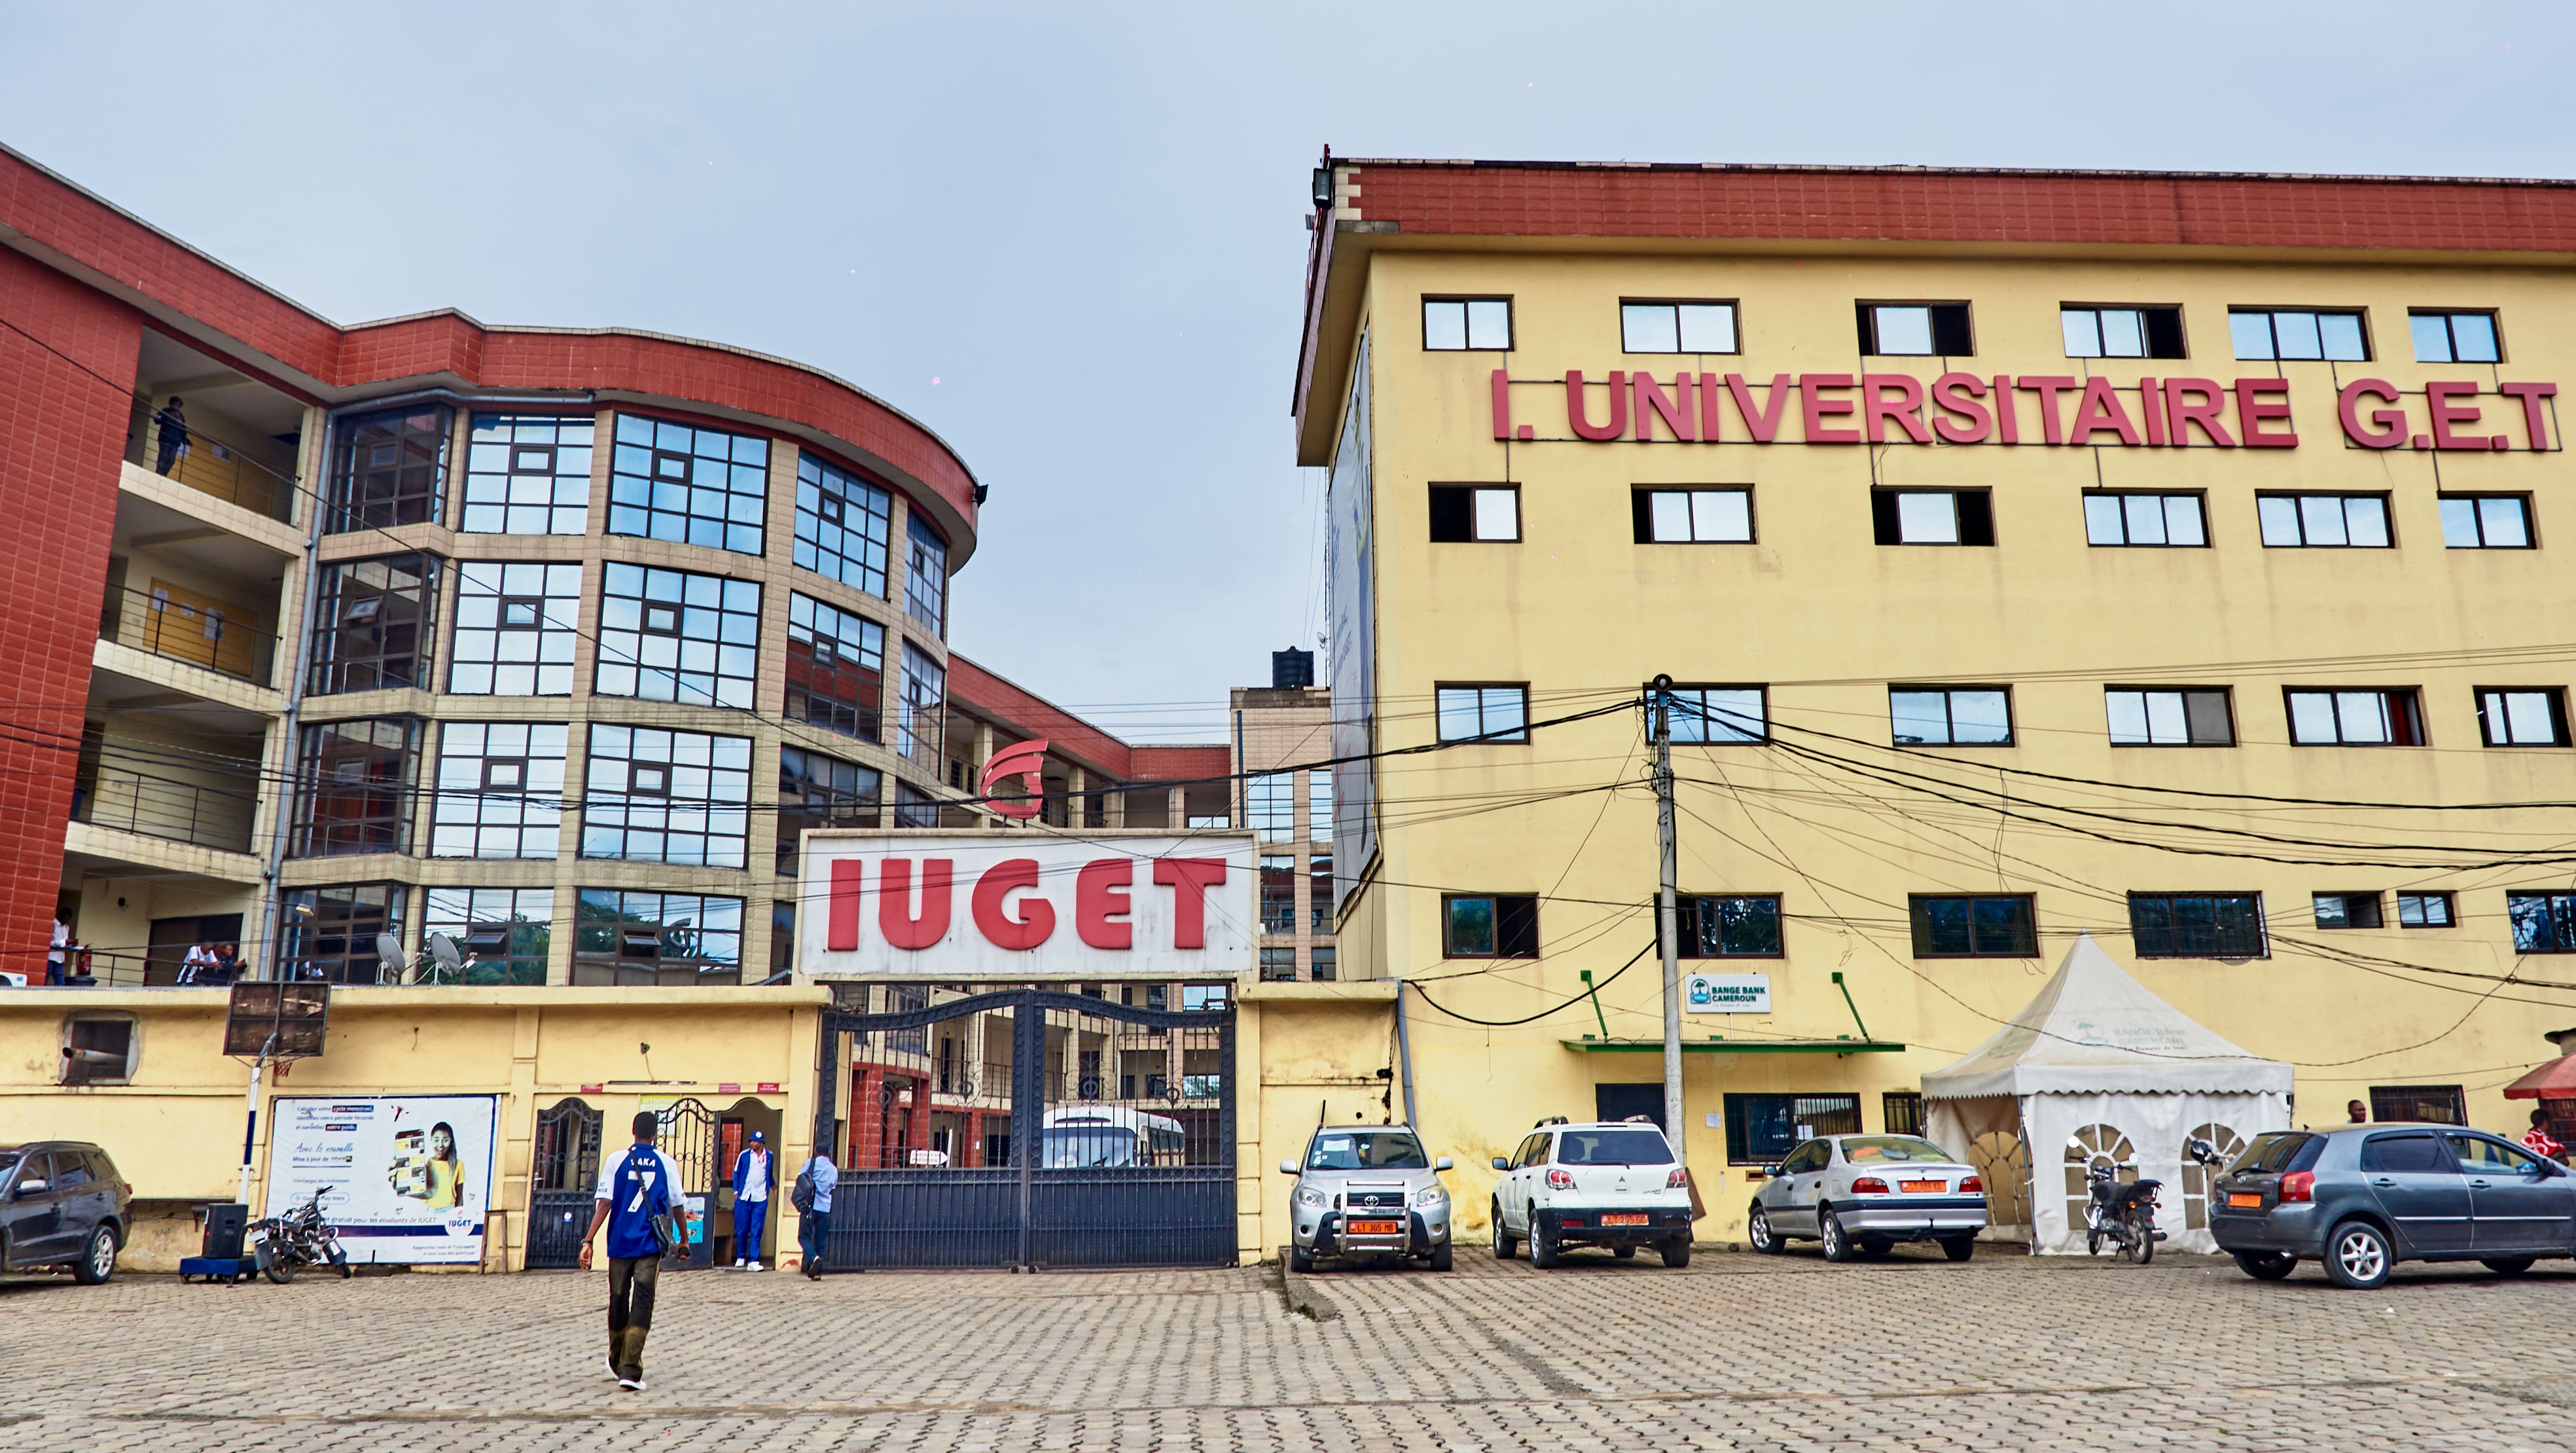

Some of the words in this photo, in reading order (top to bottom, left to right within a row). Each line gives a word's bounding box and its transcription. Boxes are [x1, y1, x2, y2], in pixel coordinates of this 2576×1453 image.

[1491, 368, 1534, 440] I.
[1565, 368, 2300, 447] UNIVERSITAIRE
[2337, 377, 2558, 450] G.E.T
[826, 857, 1227, 951] IUGET
[295, 1142, 313, 1153] Avec
[628, 1170, 656, 1212] 7
